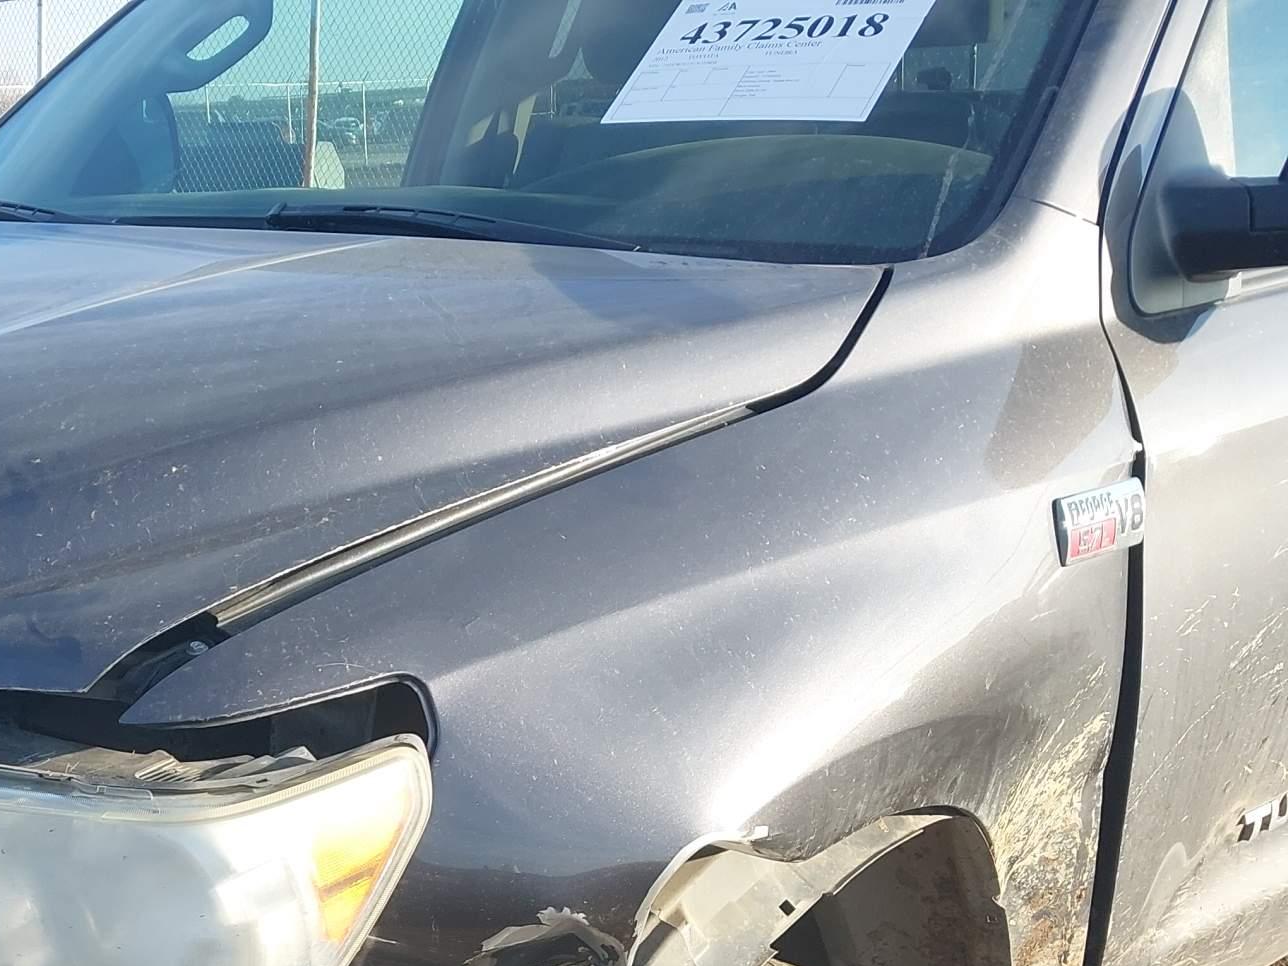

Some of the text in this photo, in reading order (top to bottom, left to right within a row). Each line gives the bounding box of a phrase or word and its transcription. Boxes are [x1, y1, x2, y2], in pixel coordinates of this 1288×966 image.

[680, 12, 890, 45] 43725018
[658, 39, 824, 55] American Family Claims Center
[1115, 493, 1144, 535] V8
